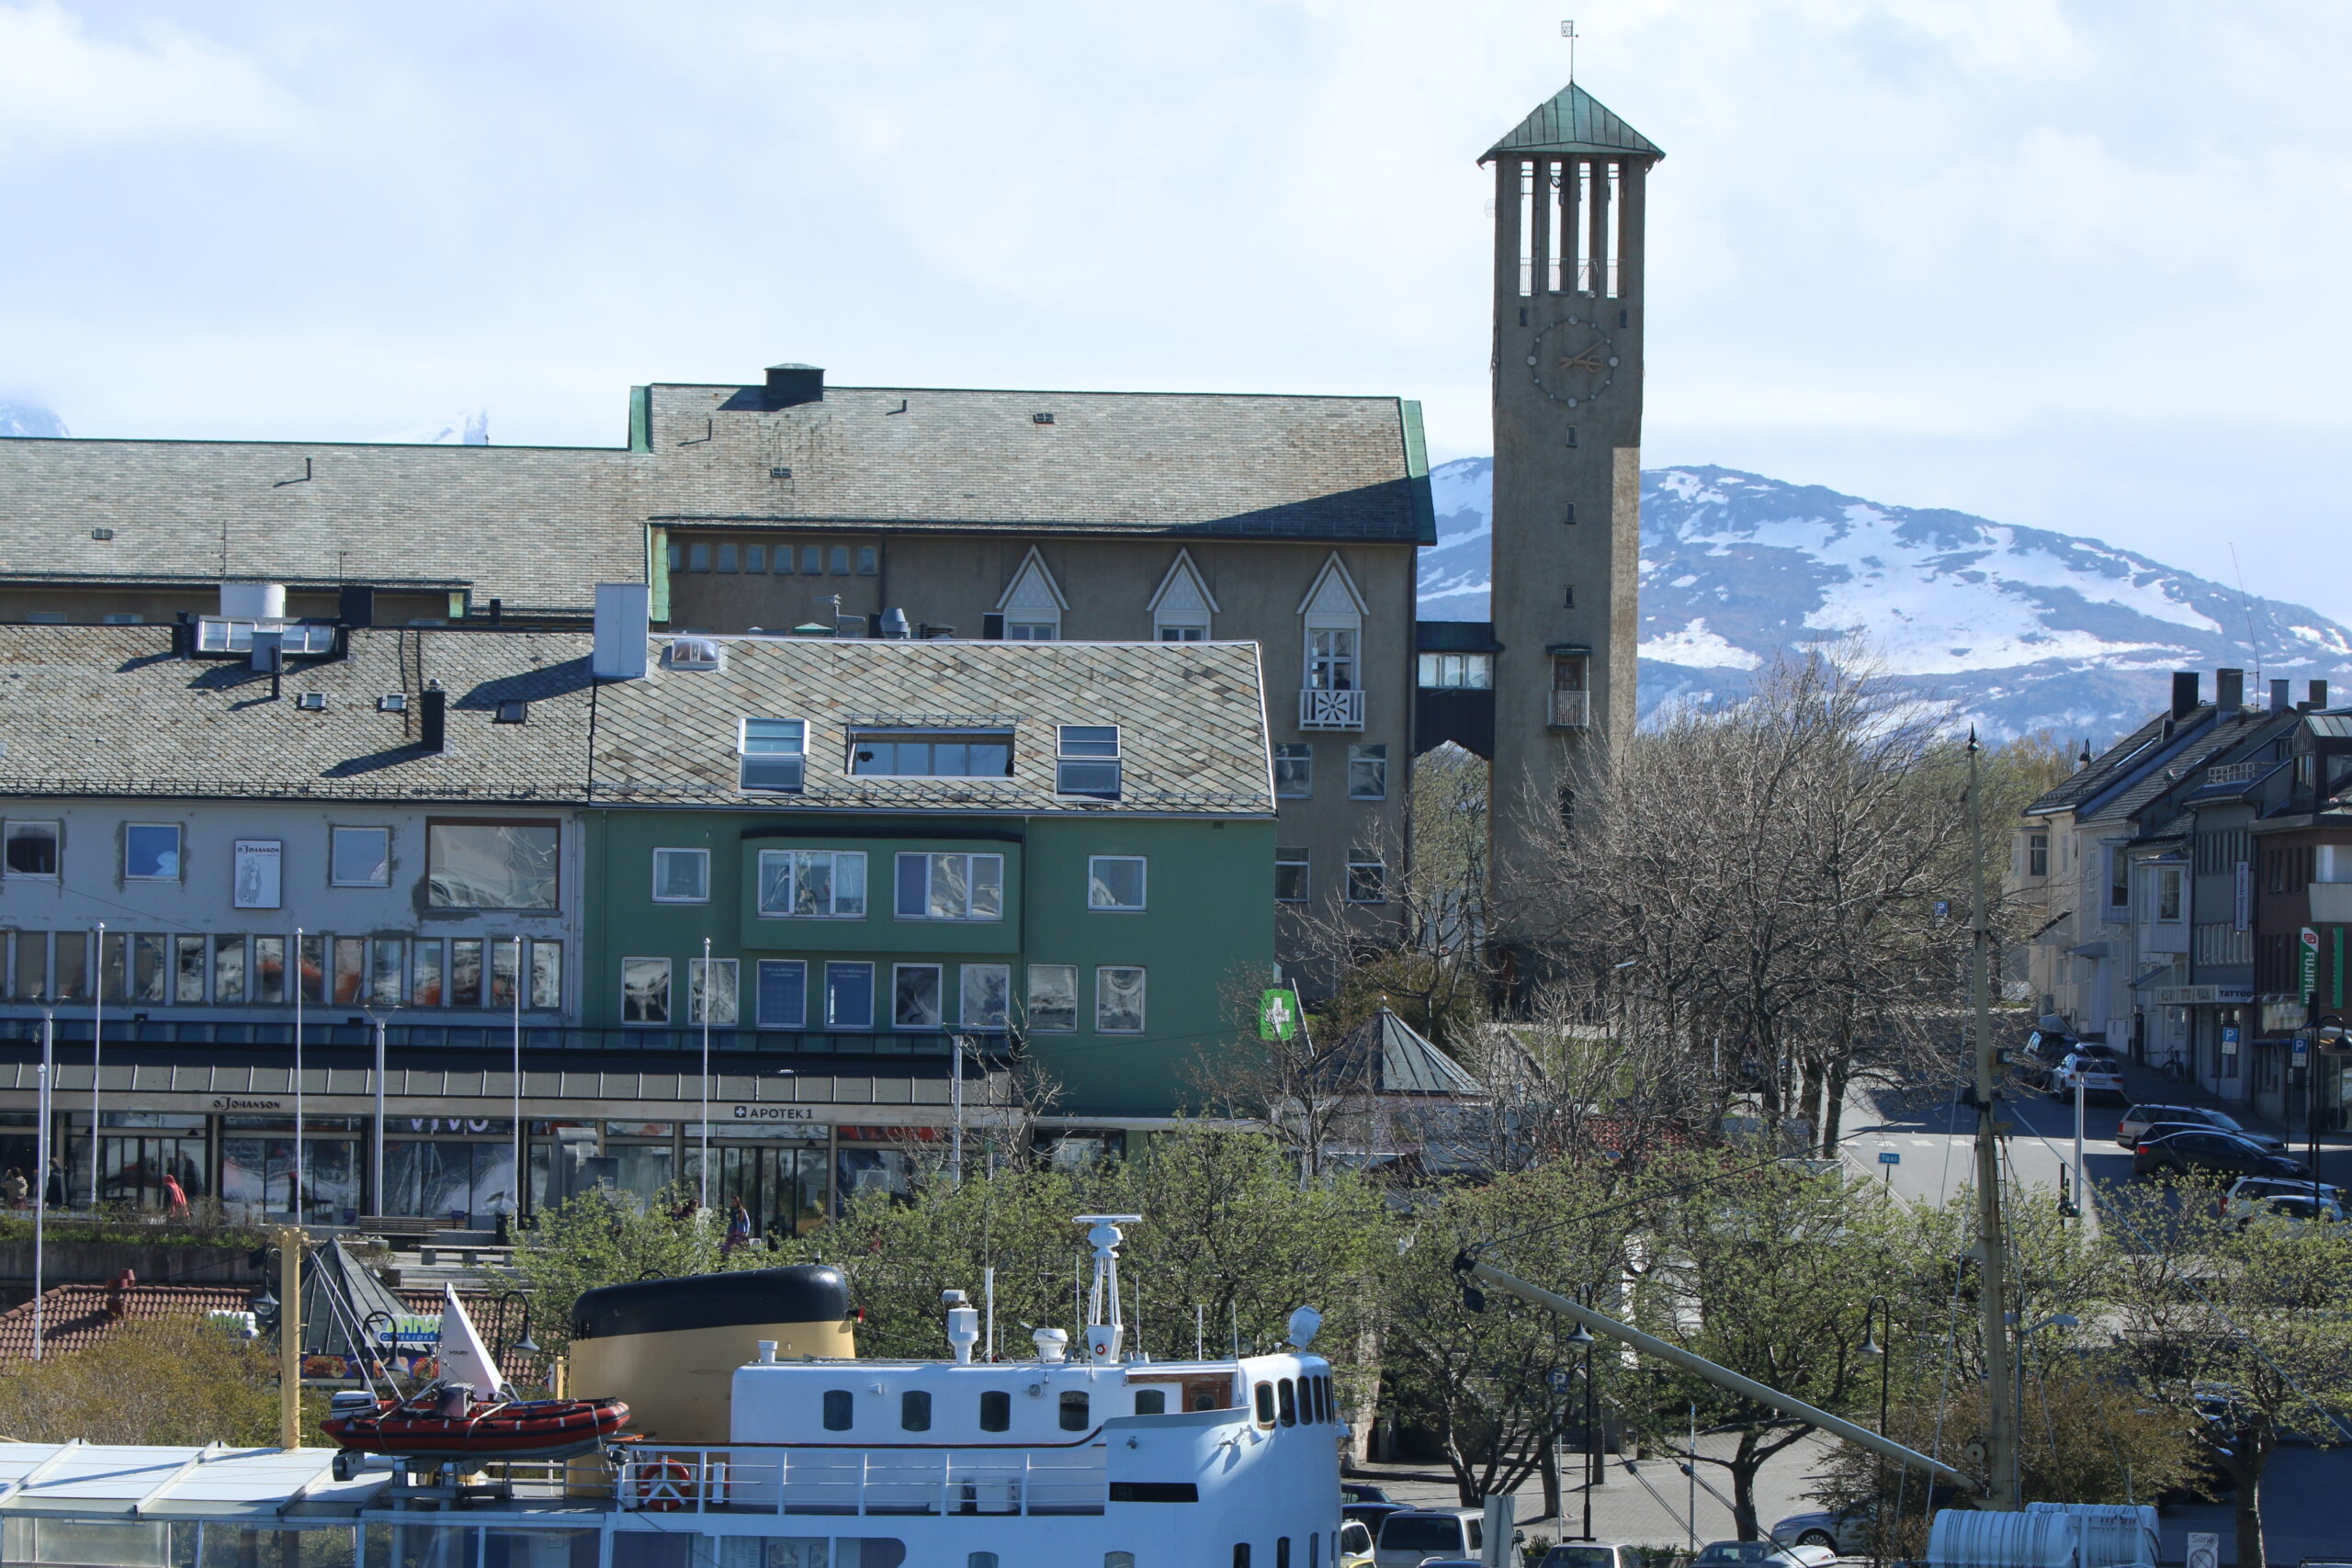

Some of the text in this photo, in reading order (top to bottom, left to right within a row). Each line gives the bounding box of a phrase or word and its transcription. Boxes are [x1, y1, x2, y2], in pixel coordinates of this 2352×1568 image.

[2226, 1029, 2234, 1040] P
[2296, 1040, 2304, 1051] P
[751, 1108, 814, 1120] APOTEK 1
[387, 1315, 443, 1333] ANNA
